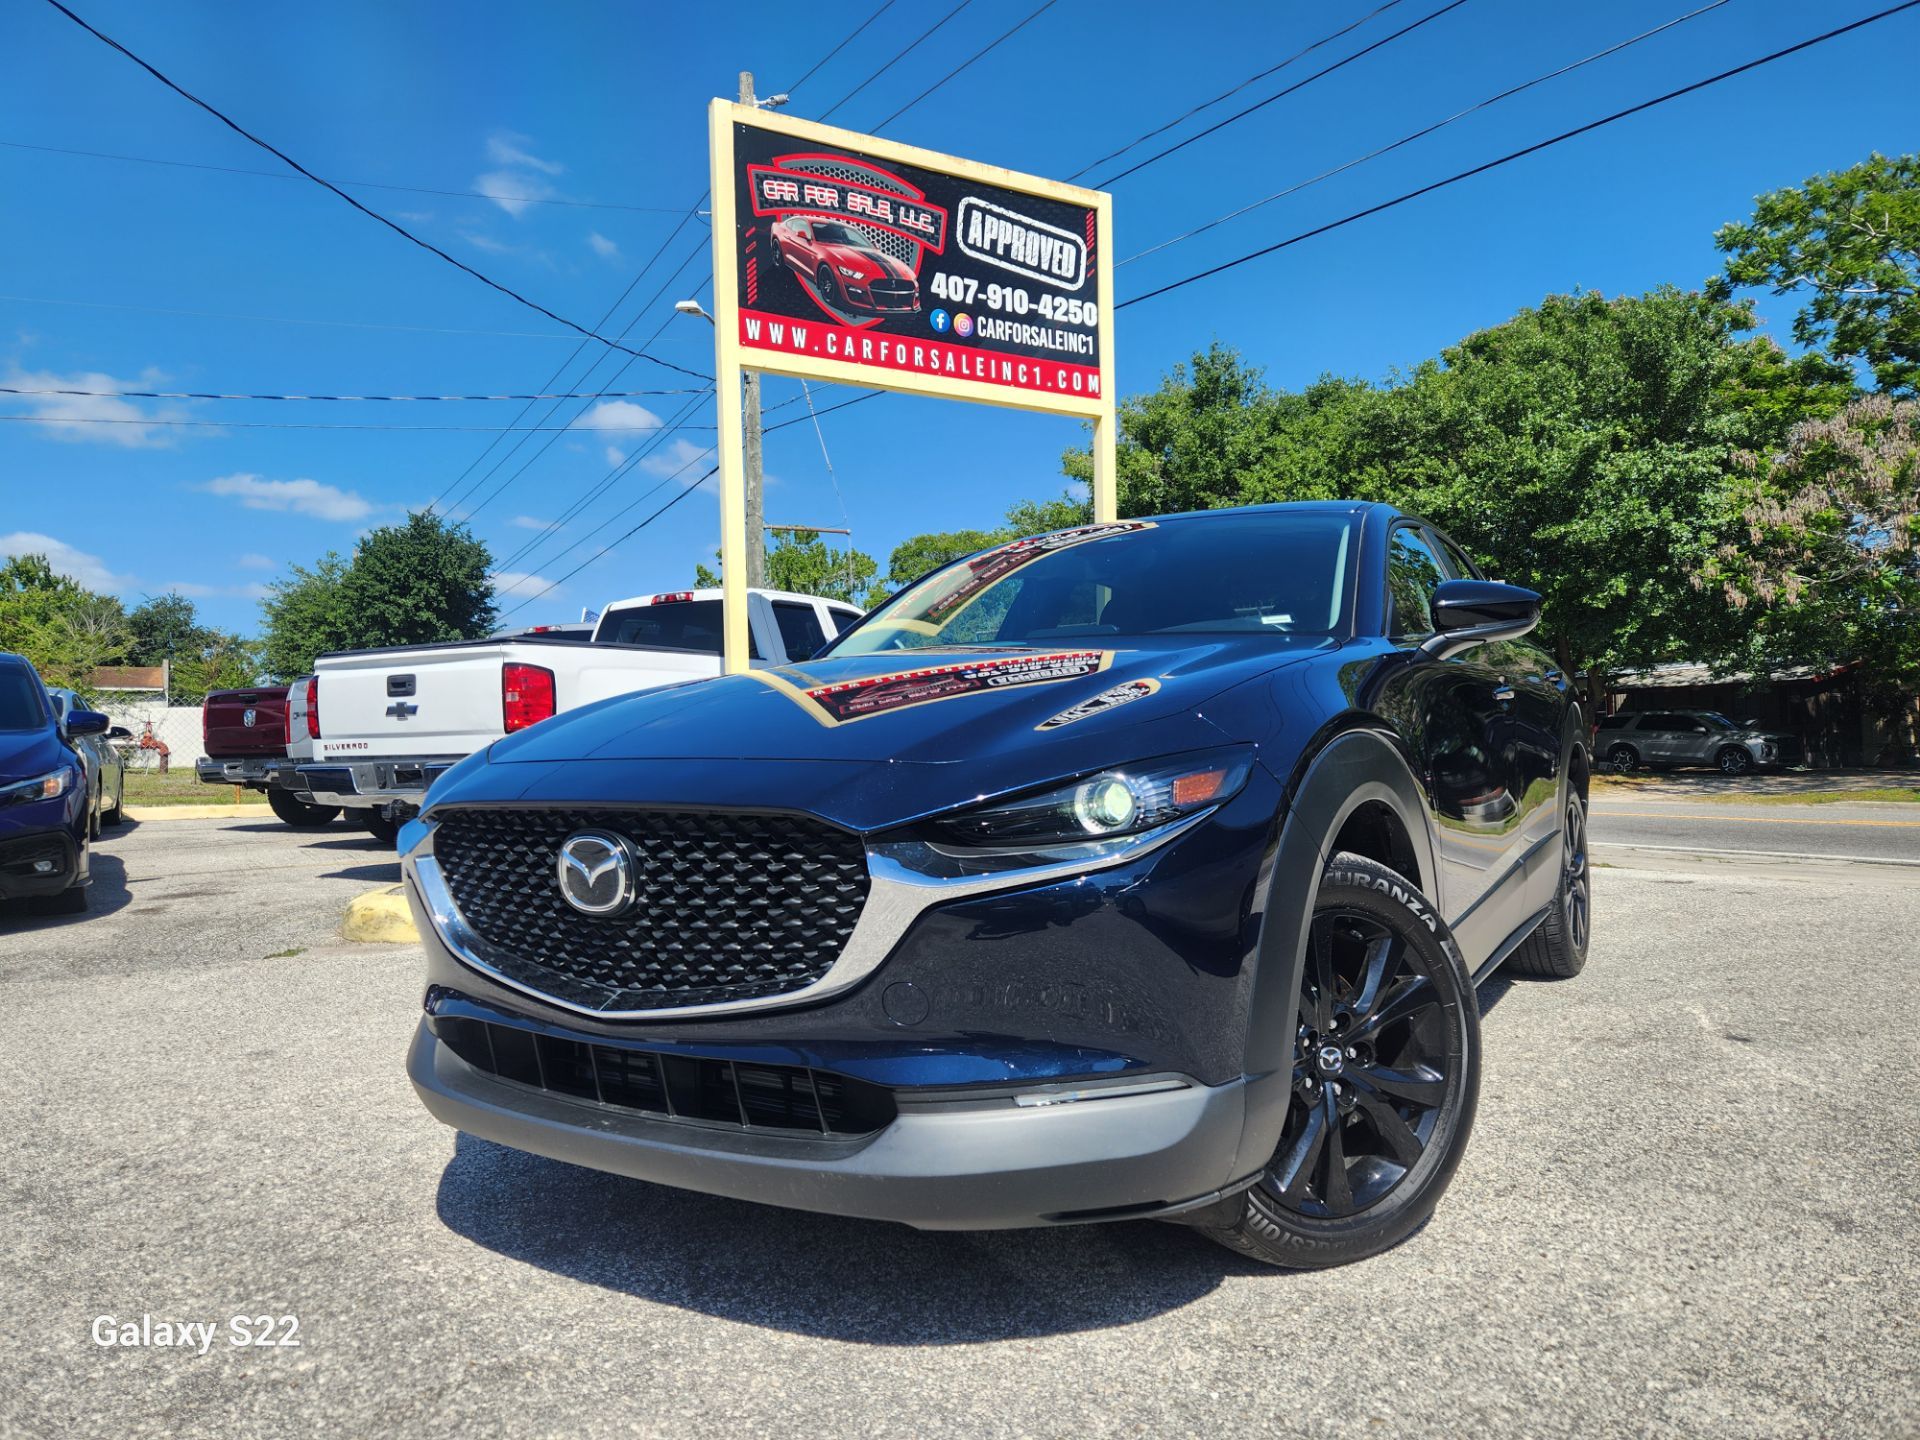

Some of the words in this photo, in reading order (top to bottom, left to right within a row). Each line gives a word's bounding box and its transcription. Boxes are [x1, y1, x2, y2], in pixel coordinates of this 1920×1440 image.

[763, 180, 799, 201] CAR
[804, 184, 839, 208] FOR
[847, 192, 893, 224] SALE,
[900, 206, 935, 233] LLC.
[967, 209, 1077, 278] APPROVED
[930, 272, 1098, 327] 407-910-4250
[745, 318, 1100, 393] WWW.CARFORSALEINC1.COM
[977, 316, 1094, 355] CARFORSALEINC1
[323, 742, 368, 751] SILVERADO
[1323, 872, 1437, 933] TURANZA
